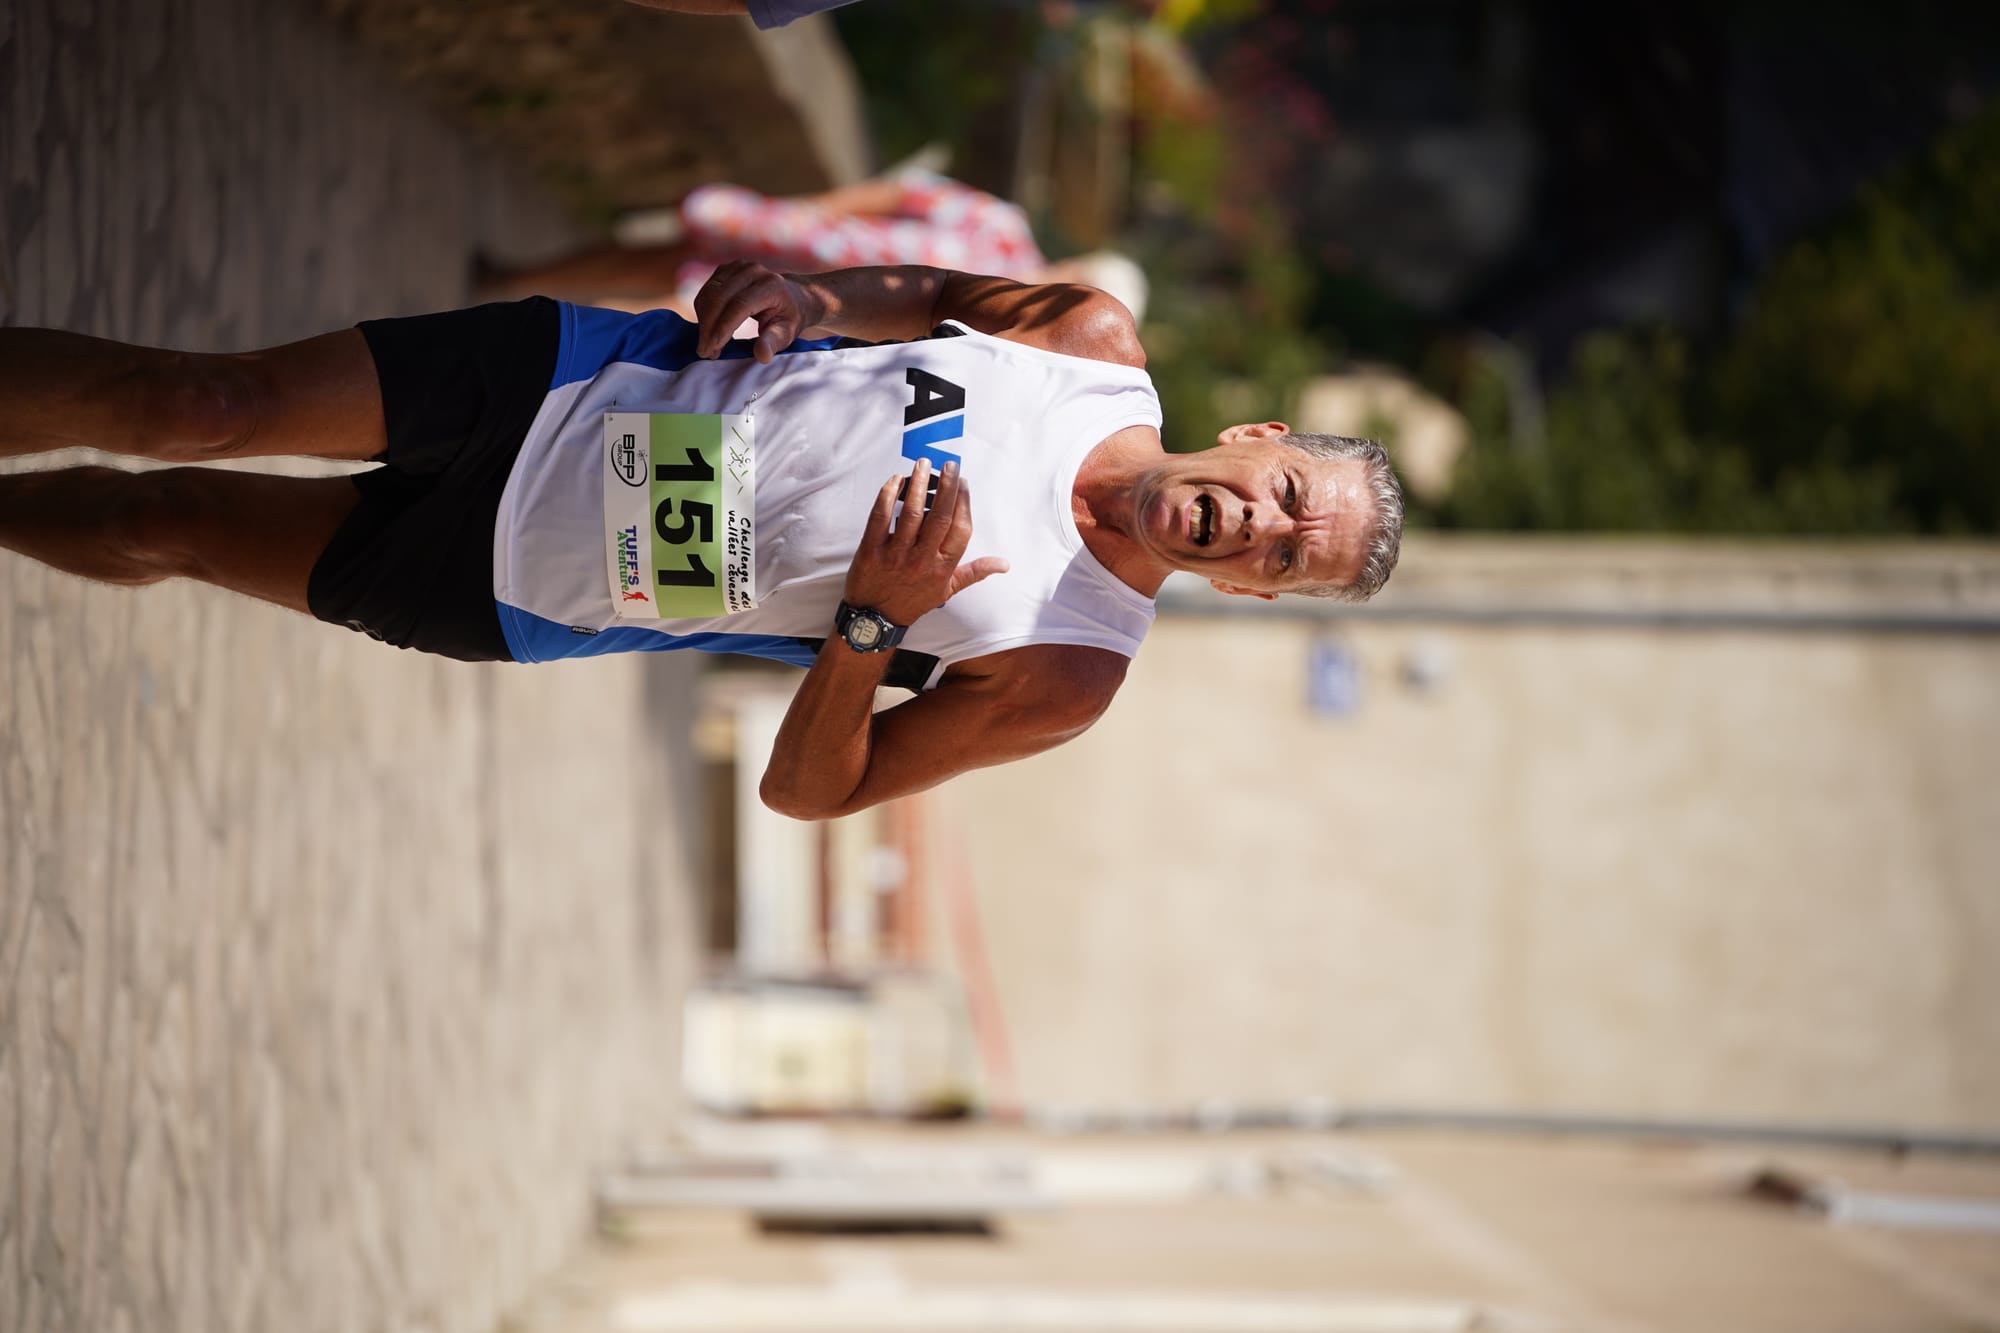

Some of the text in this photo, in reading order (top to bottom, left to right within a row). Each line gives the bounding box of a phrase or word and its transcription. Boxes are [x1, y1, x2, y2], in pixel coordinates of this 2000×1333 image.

[623, 434, 635, 479] BFP
[655, 447, 715, 587] 151
[617, 531, 629, 591] Aventure
[625, 525, 640, 586] TUFF'S
[728, 510, 741, 612] vallées cévenoles
[737, 517, 752, 609] Challenge des
